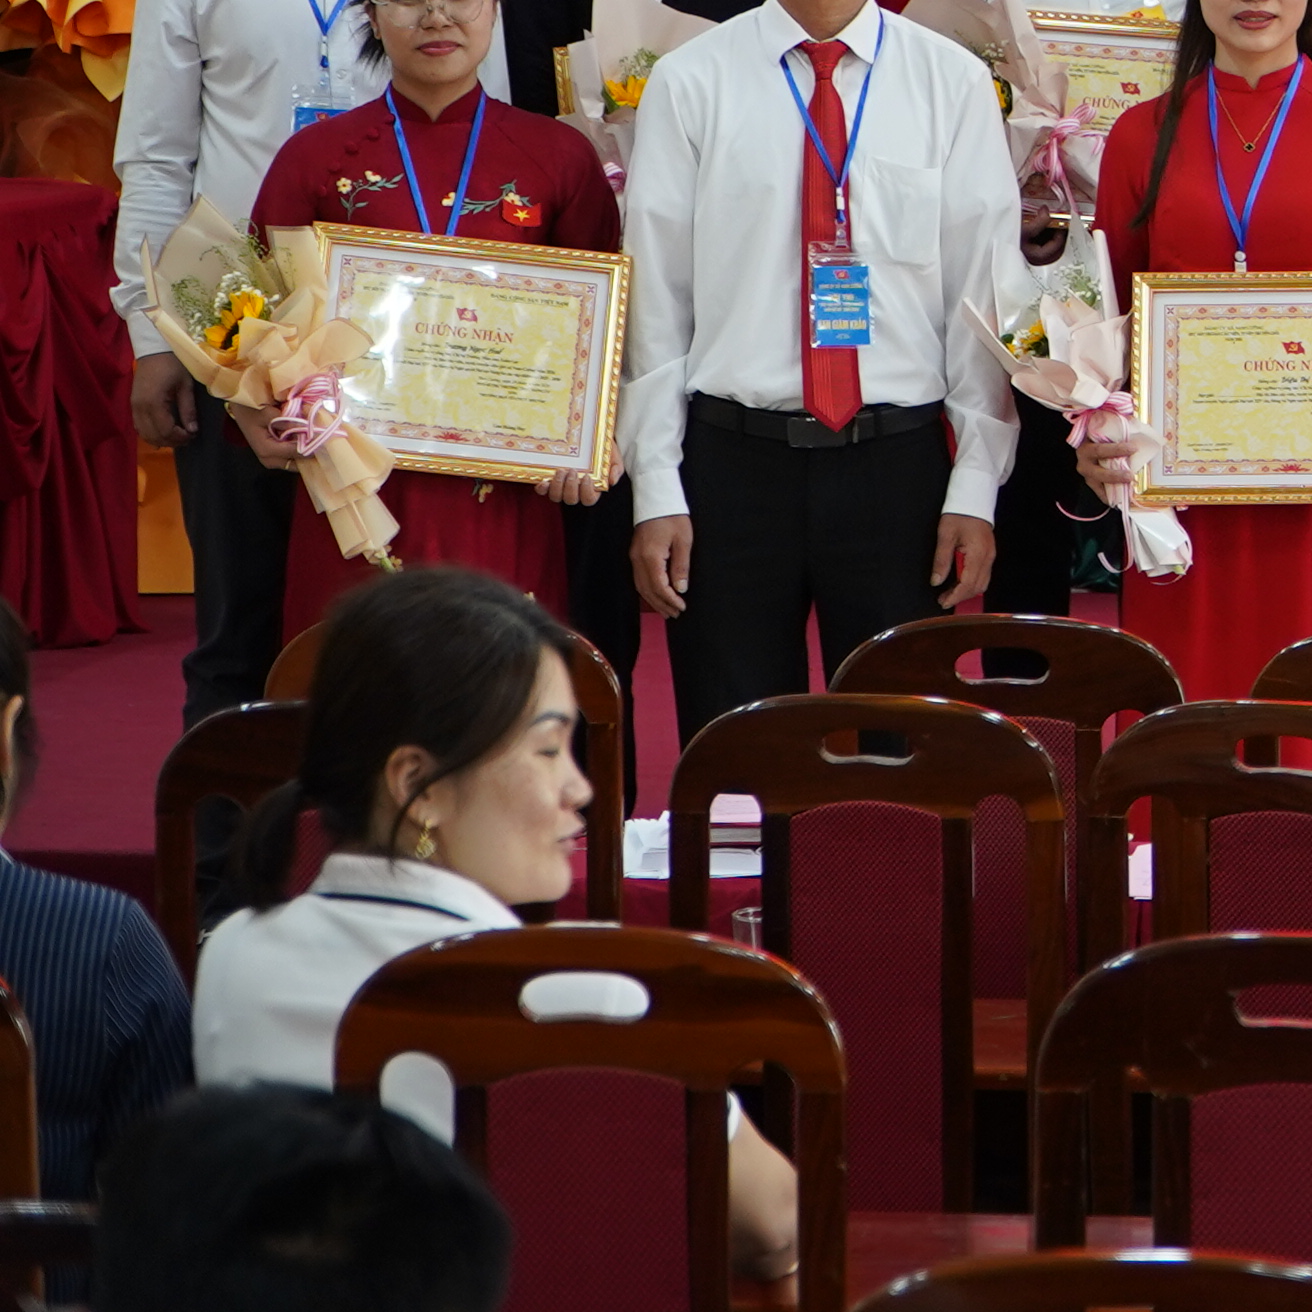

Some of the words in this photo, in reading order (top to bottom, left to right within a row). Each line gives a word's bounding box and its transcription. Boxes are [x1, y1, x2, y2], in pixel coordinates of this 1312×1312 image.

[415, 321, 467, 338] CHỨNG
[473, 328, 514, 345] NHẬN
[1244, 358, 1296, 372] CHỨNG
